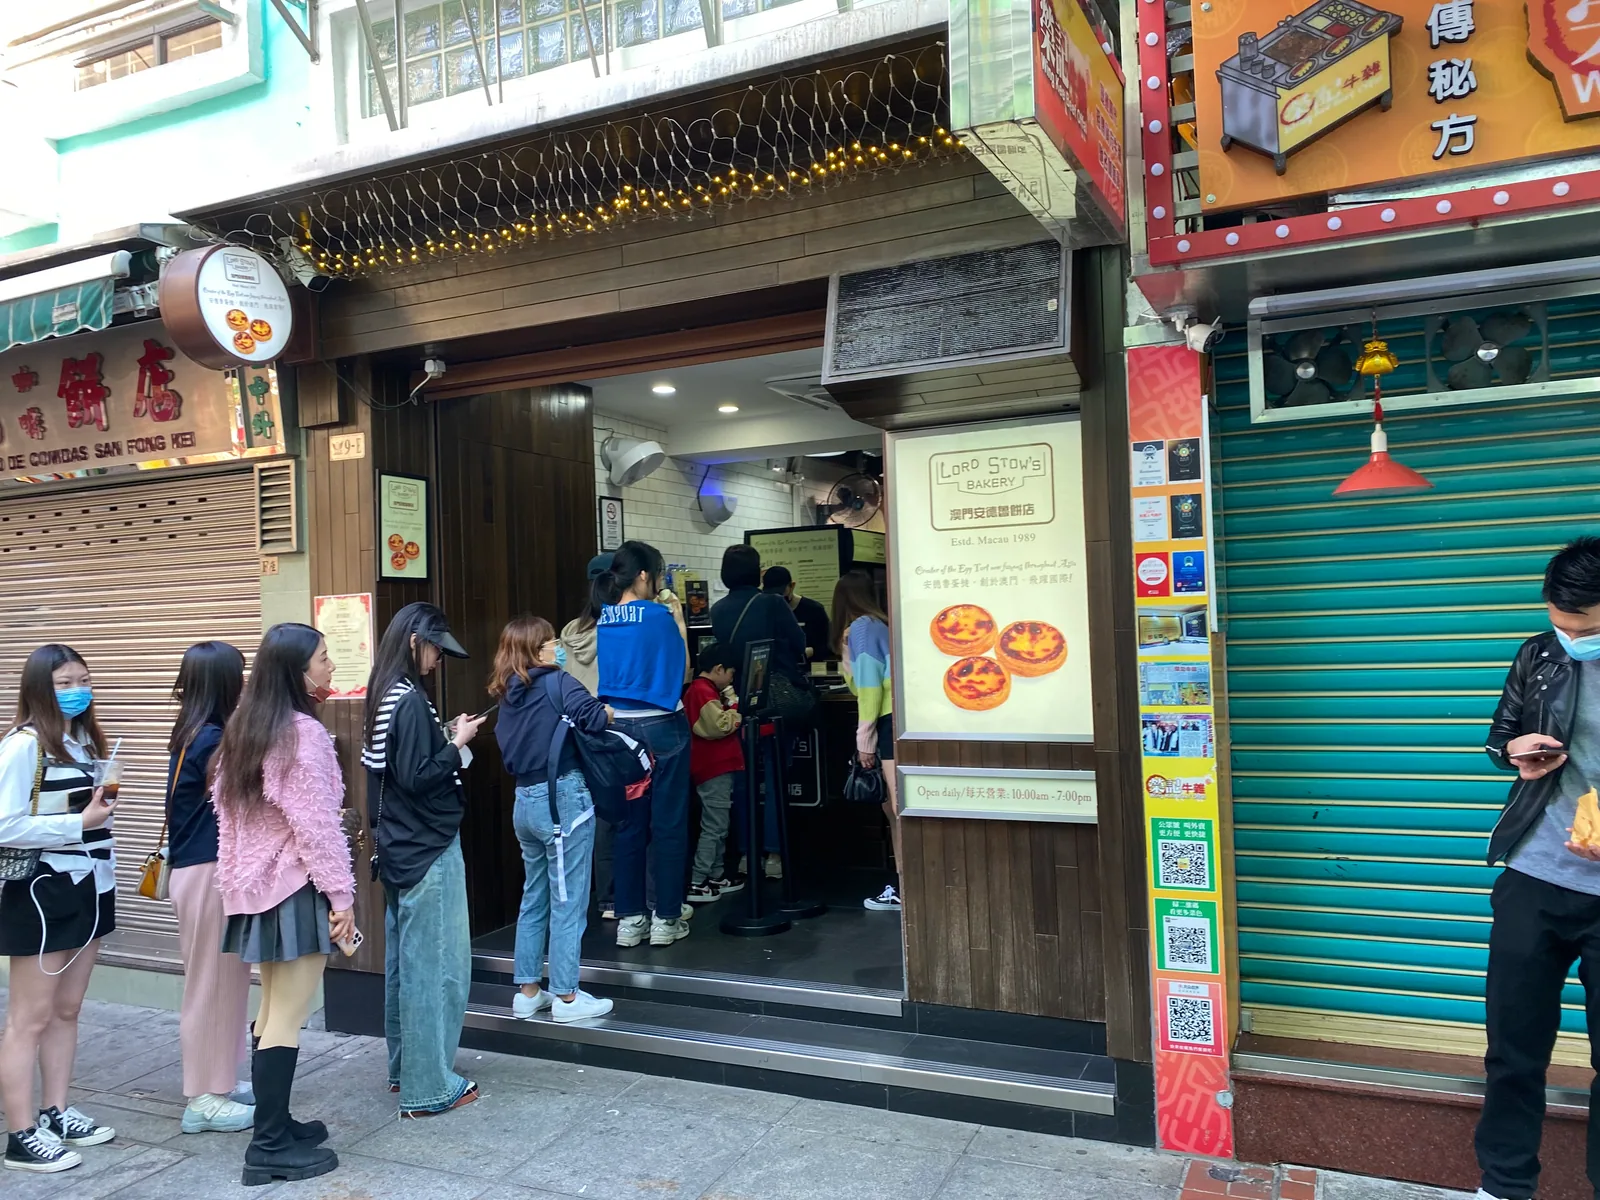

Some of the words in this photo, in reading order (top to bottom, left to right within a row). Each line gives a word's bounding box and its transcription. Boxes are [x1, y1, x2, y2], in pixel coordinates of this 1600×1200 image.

[1426, 0, 1478, 159] 傳秘方
[8, 454, 26, 470] DE
[94, 440, 123, 459] SAN
[126, 435, 166, 455] FONG
[940, 458, 980, 479] LORD
[966, 477, 1016, 490] BAKERY
[951, 537, 975, 547] Estd.
[978, 536, 1009, 545] Macau
[1013, 533, 1036, 543] 1989
[917, 785, 940, 797] Open
[1012, 788, 1049, 801] 10:00am
[1057, 790, 1092, 805] 7:00pm
